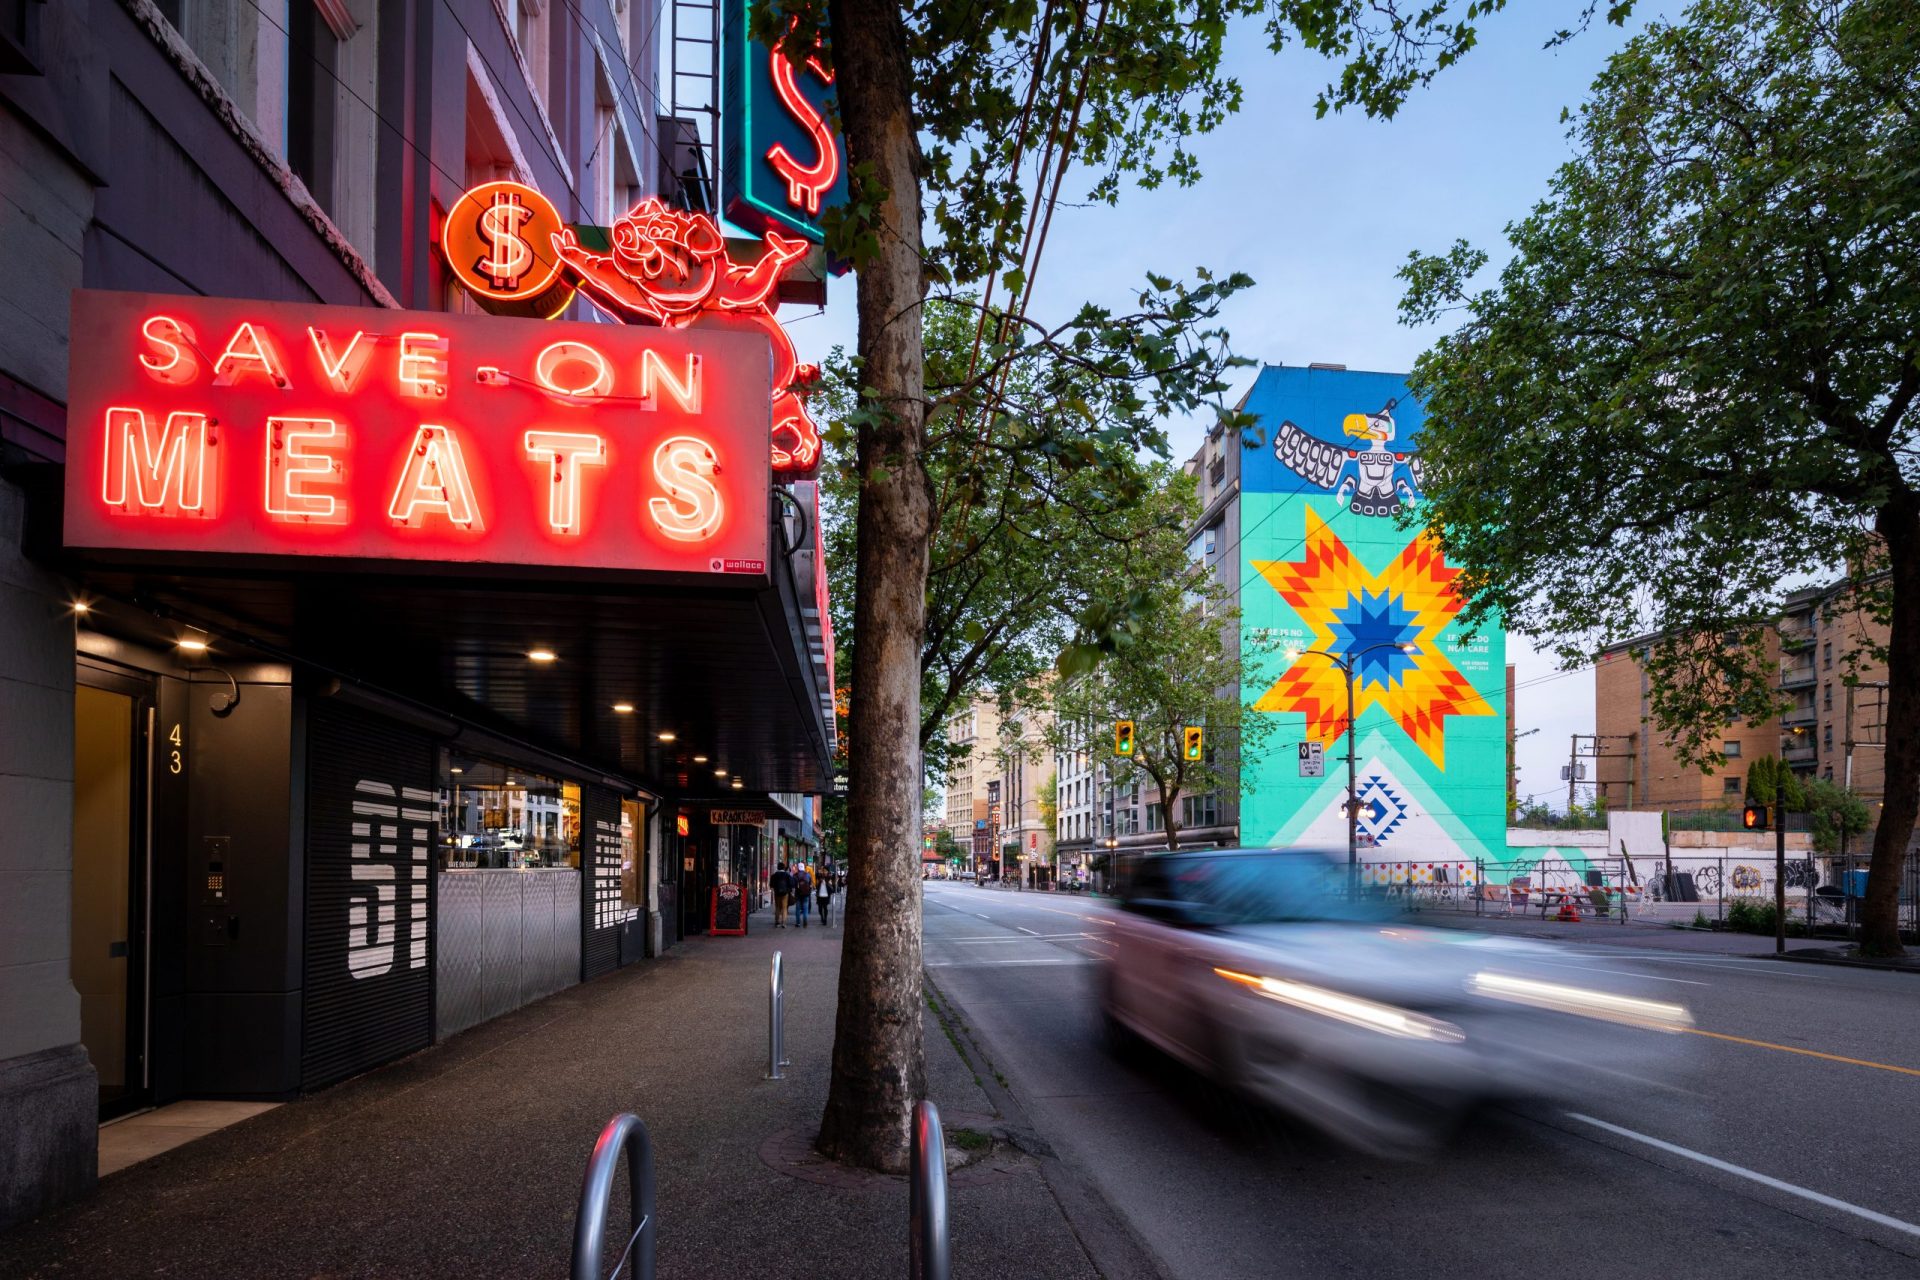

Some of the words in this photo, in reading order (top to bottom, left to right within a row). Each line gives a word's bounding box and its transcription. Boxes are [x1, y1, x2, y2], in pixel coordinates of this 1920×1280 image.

[475, 190, 534, 289] $
[102, 407, 725, 542] MEATS
[726, 560, 762, 569] wallace
[1291, 629, 1303, 637] NO
[1477, 635, 1489, 643] DO
[1467, 645, 1489, 653] CARE
[712, 811, 746, 823] KARAOKE
